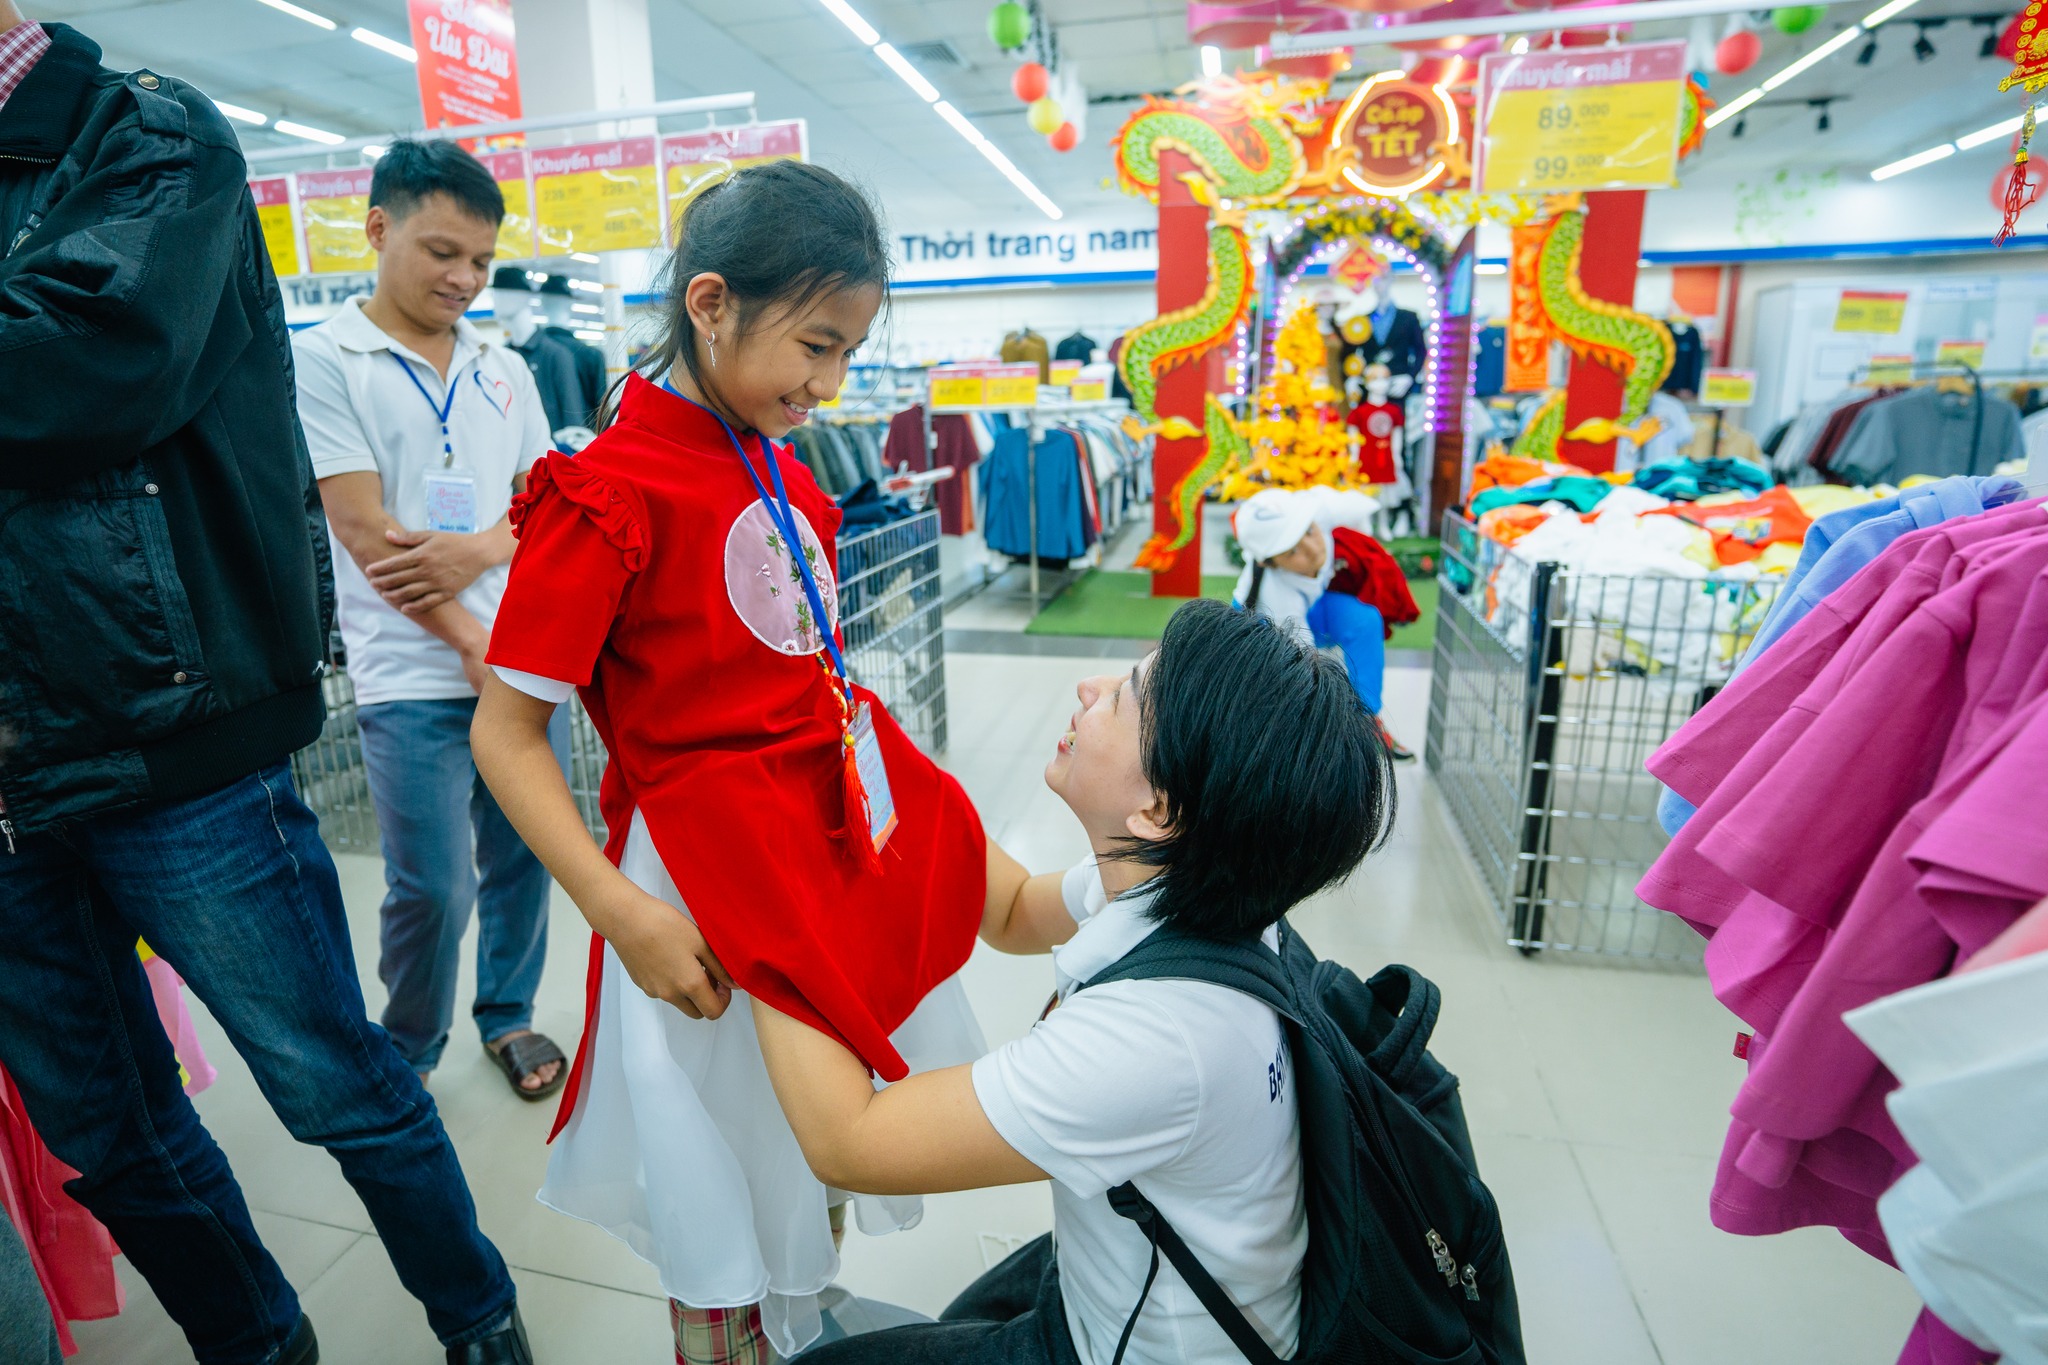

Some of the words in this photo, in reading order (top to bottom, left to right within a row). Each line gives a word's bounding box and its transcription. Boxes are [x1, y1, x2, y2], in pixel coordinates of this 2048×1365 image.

[899, 231, 973, 263] Thời
[988, 231, 1077, 263] trang
[1089, 228, 1157, 252] nam
